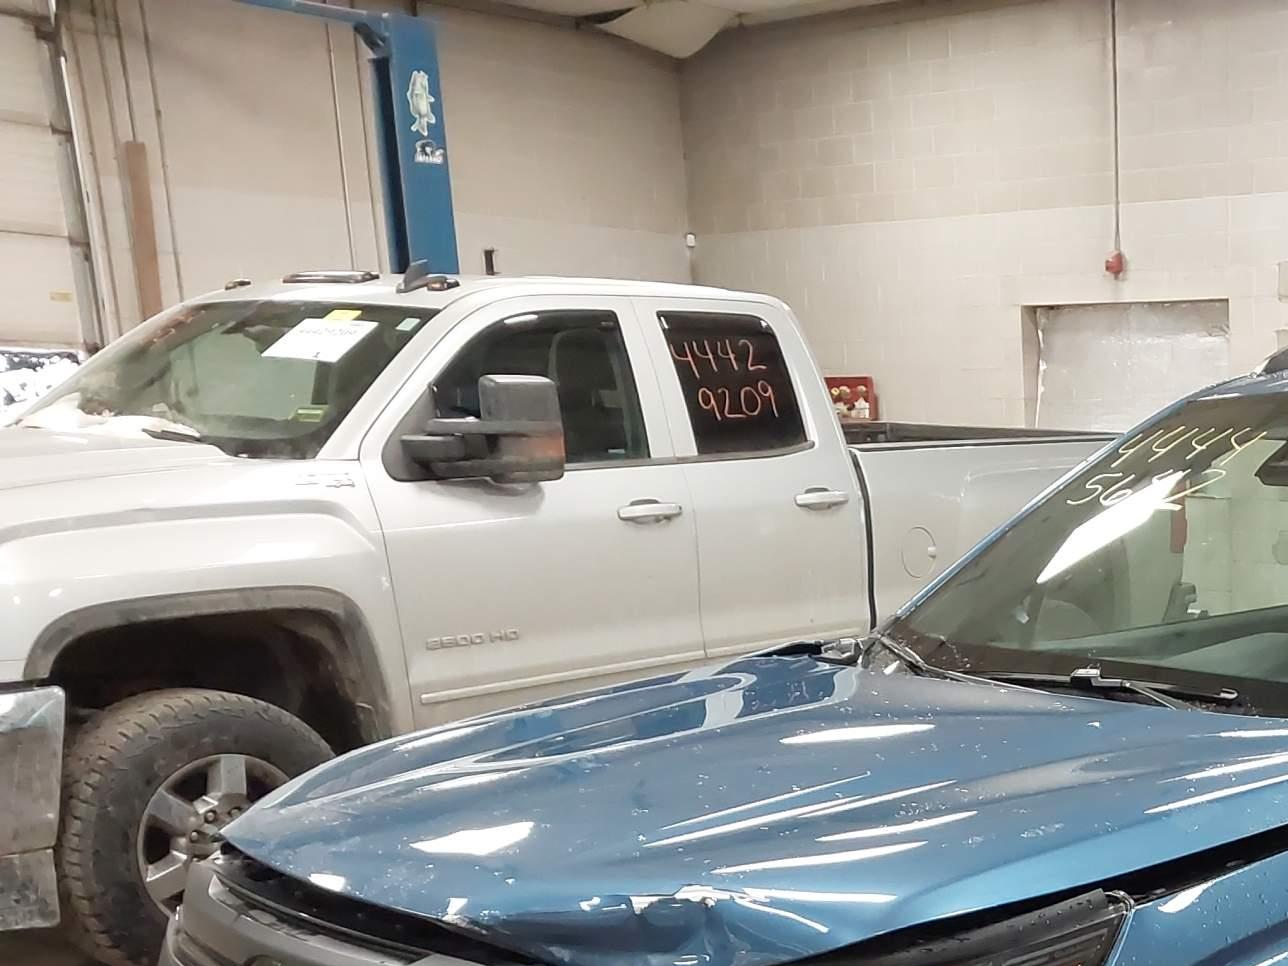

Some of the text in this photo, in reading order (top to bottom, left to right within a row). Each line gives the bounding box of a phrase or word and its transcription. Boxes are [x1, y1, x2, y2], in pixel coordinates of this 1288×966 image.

[670, 339, 767, 378] 4442
[698, 380, 779, 421] 9209
[1110, 426, 1268, 468] 4444
